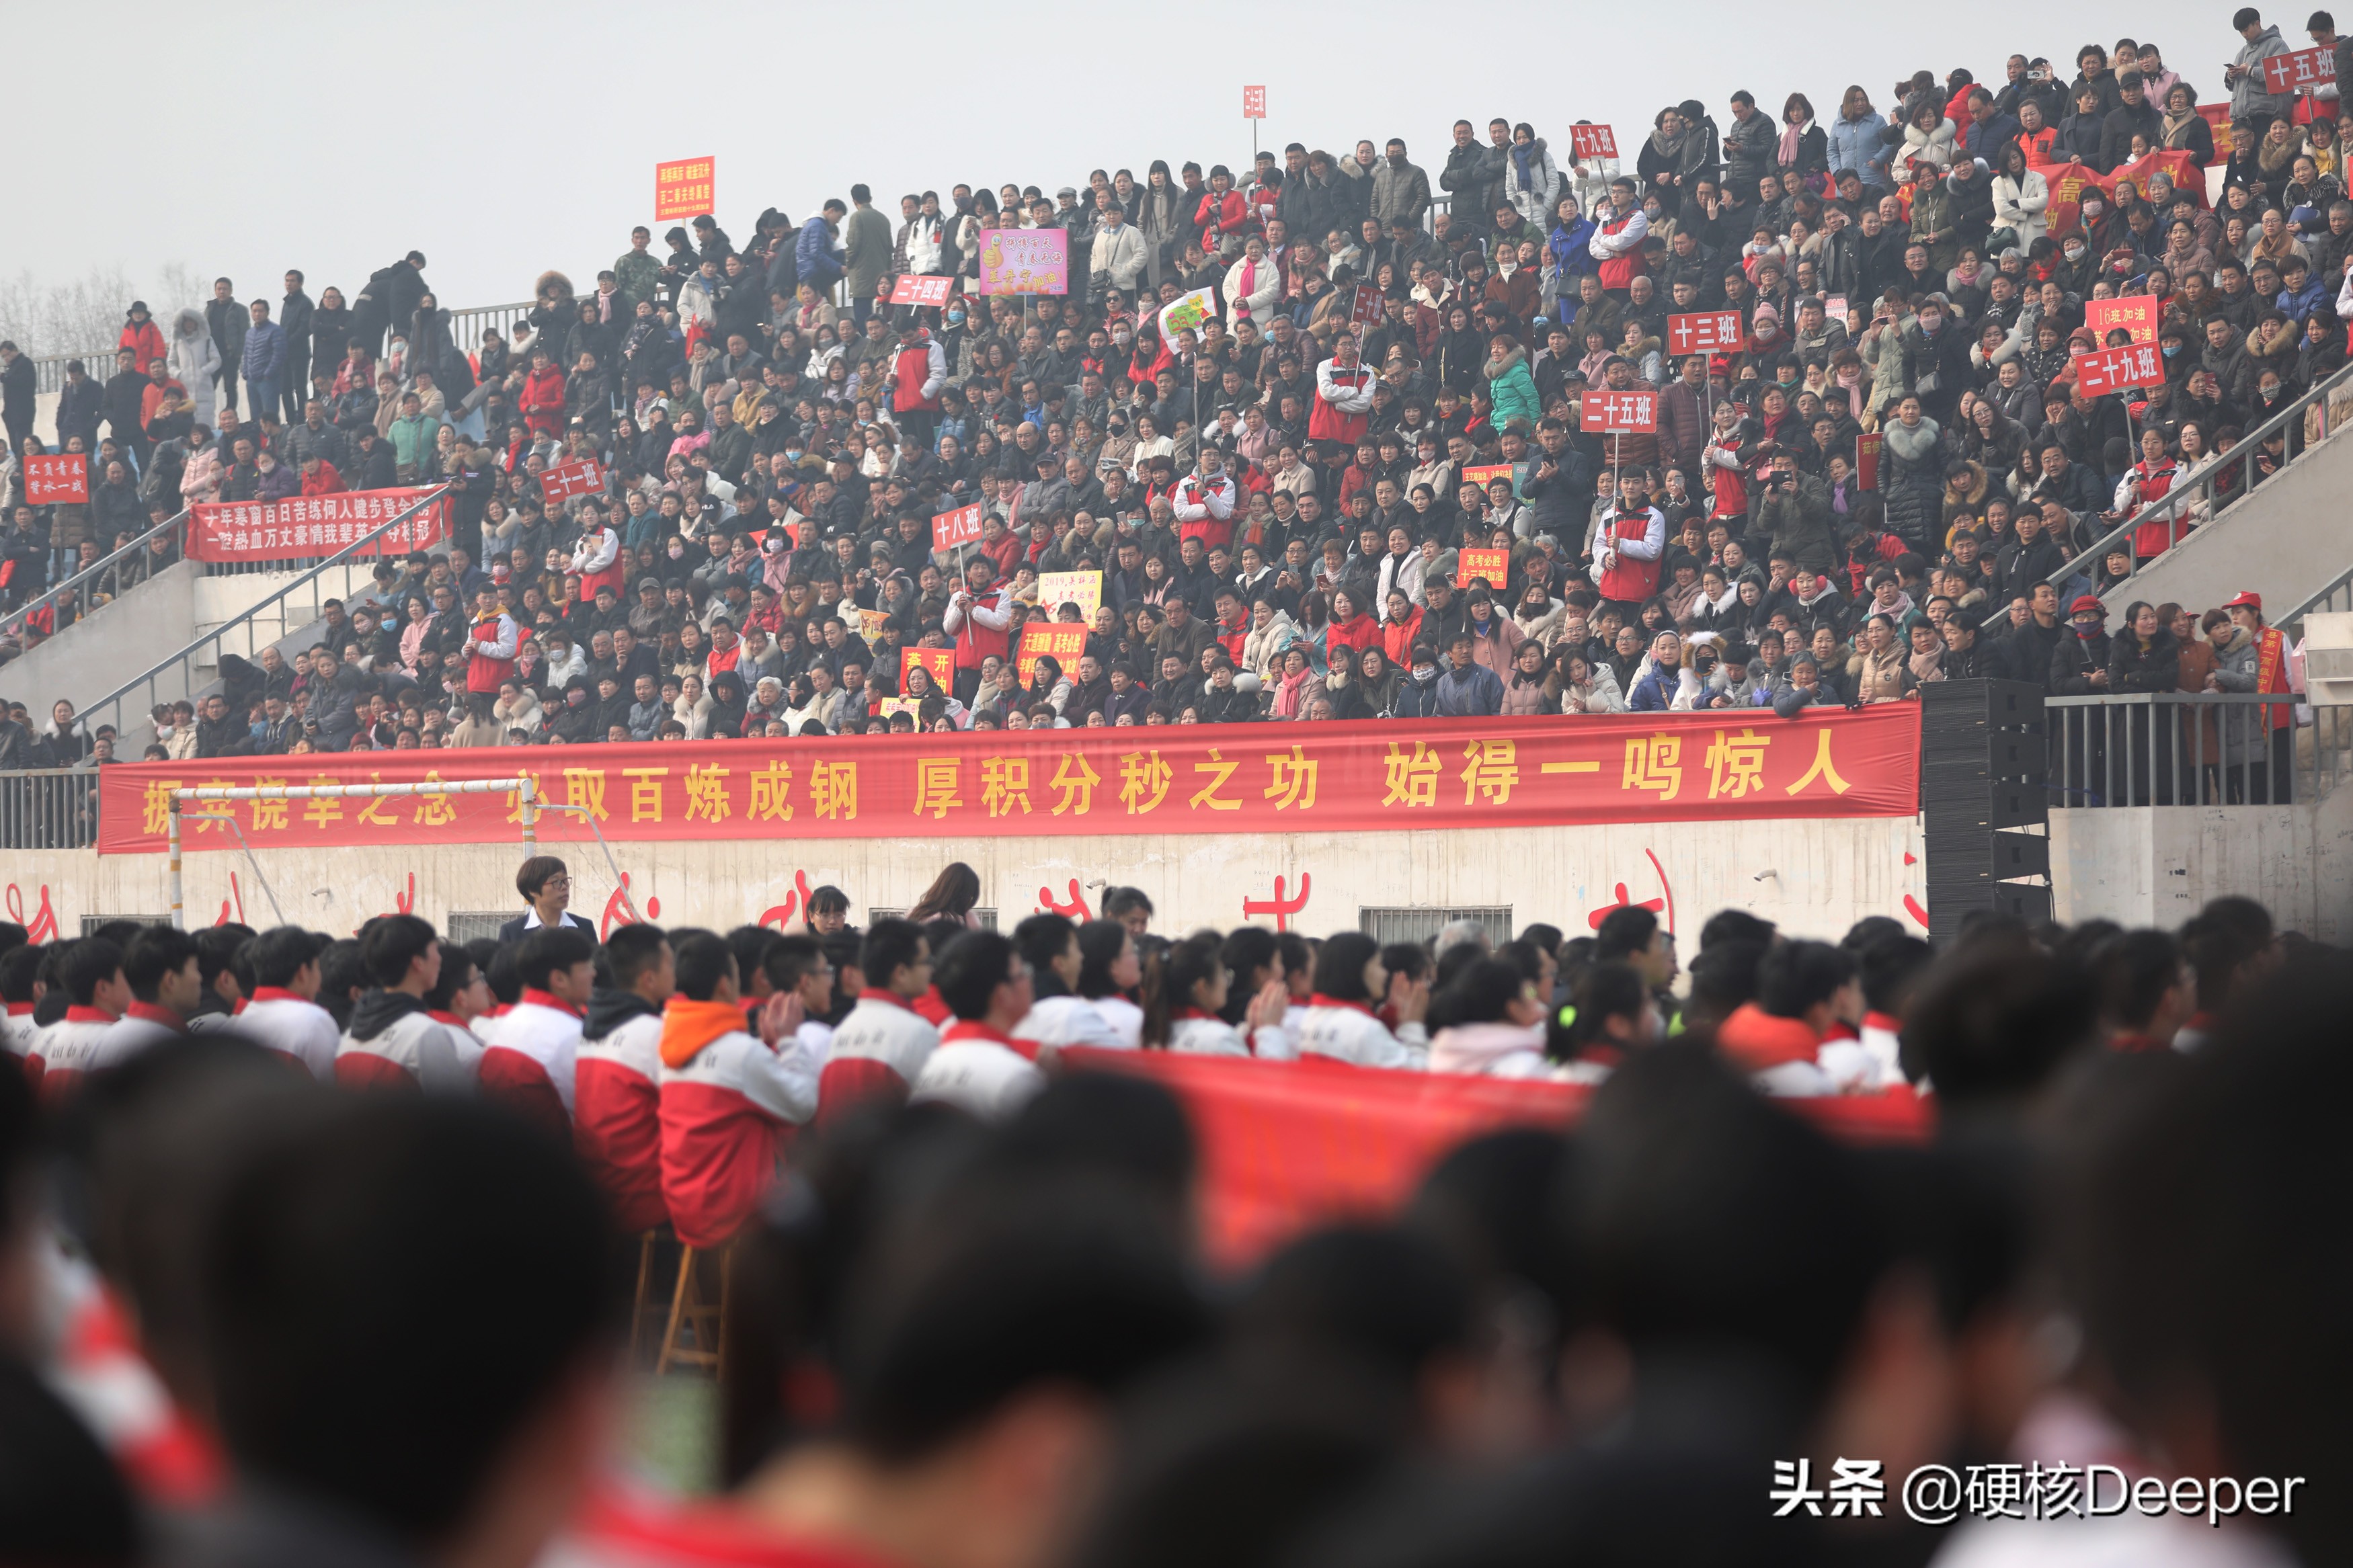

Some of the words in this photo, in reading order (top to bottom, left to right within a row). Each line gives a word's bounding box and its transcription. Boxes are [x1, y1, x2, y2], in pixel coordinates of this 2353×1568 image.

[2271, 48, 2336, 86] 十五班
[1245, 88, 1264, 113] 二十三班
[1575, 127, 1613, 153] 十九班
[1005, 235, 1053, 251] 拼搏百天
[1016, 250, 1064, 266] 青春无悔
[898, 278, 949, 300] 二十四班
[1356, 292, 1384, 320] 二十班
[2098, 305, 2146, 326] 16班加油
[1675, 315, 1737, 348] 十三班
[2094, 325, 2153, 346] 苏加油
[2085, 347, 2158, 386] 二十九班
[1587, 395, 1652, 426] 二十五班
[546, 462, 600, 495] 二十一班
[936, 507, 980, 545] 十八班
[1467, 554, 1502, 567] 高考必胜
[1461, 569, 1505, 582] 十三班加油
[1053, 632, 1081, 653] 高考必胜
[506, 760, 858, 825] 必取百炼成钢
[913, 745, 1319, 820] 厚积分秒之功
[1382, 729, 1851, 808] 始得一鸣惊人
